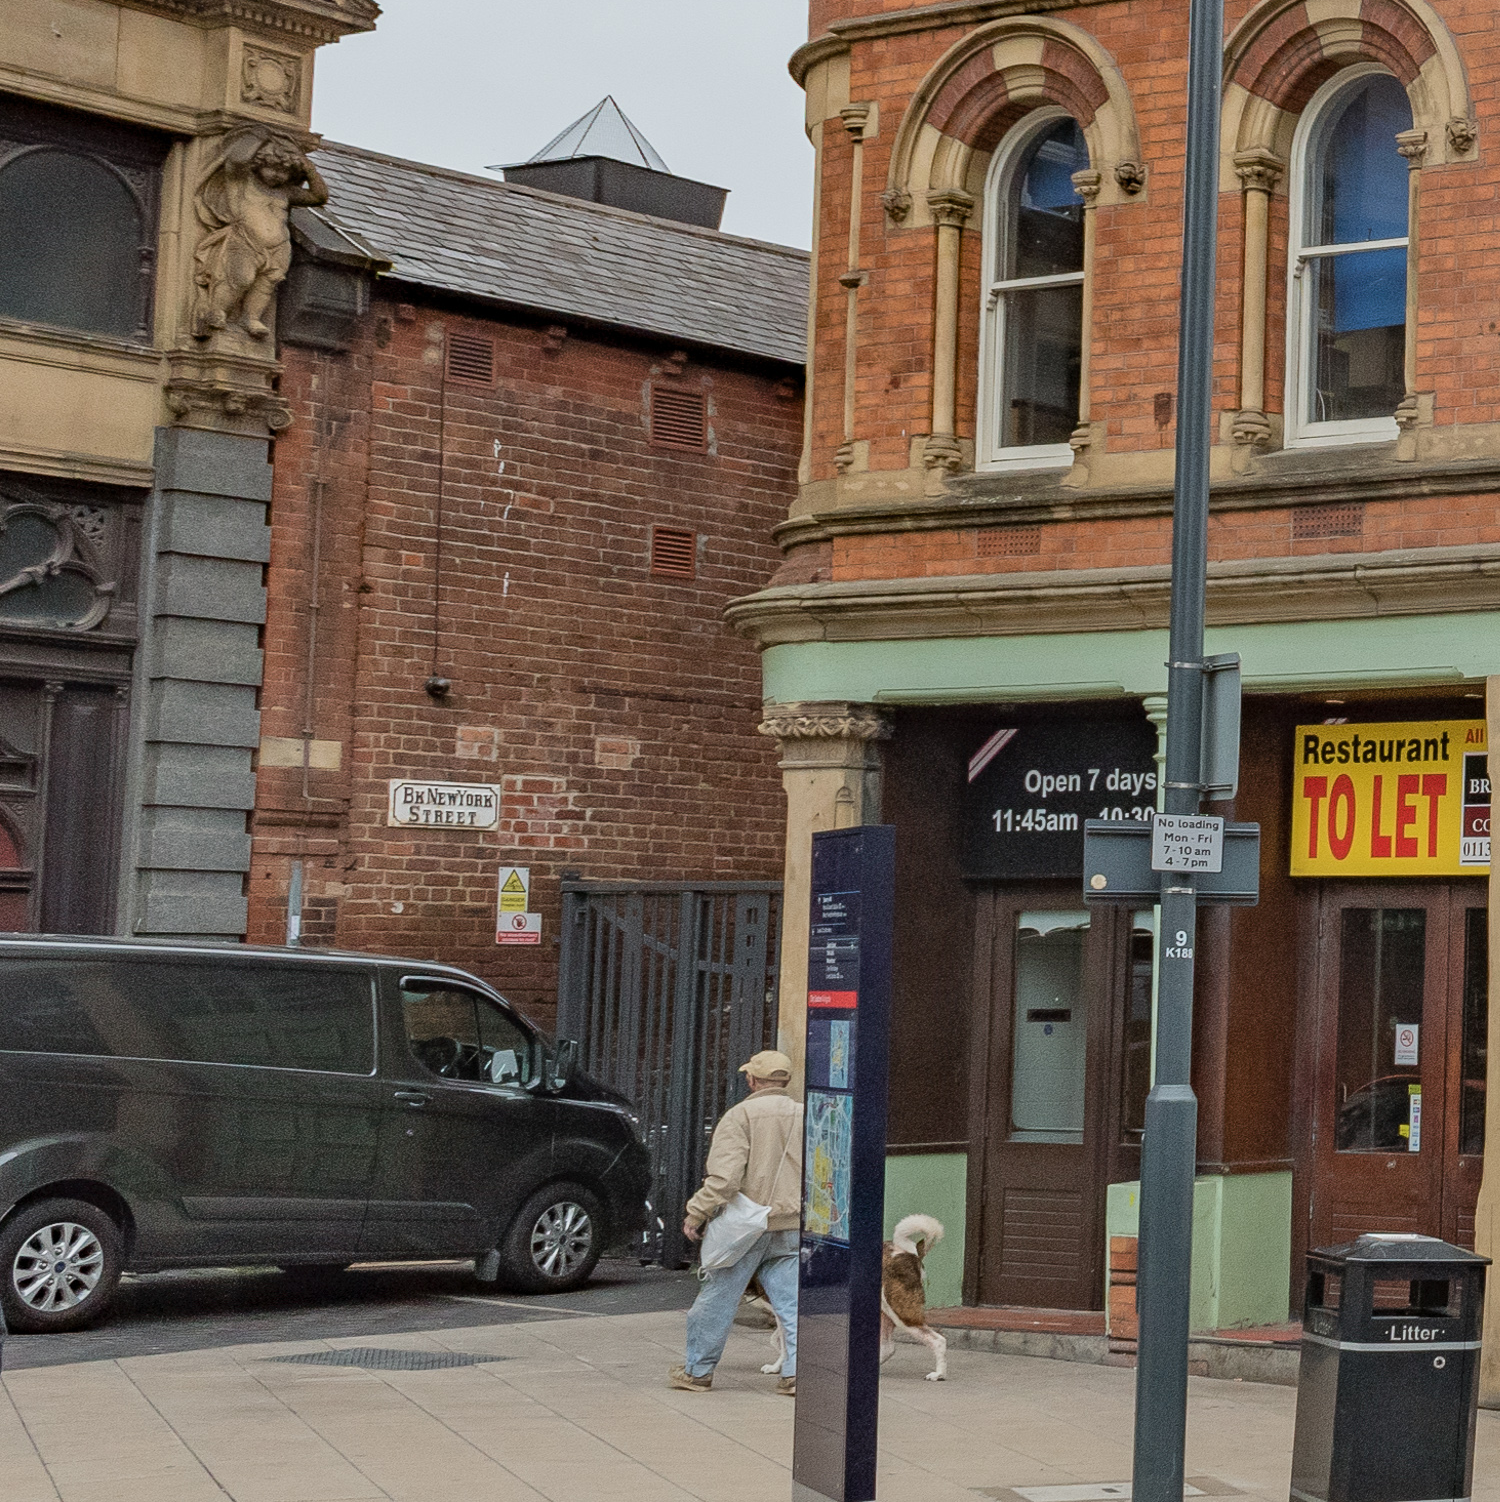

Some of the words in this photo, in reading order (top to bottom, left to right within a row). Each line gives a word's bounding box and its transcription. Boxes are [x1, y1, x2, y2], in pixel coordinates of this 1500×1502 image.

[1303, 731, 1450, 764] Restaurant
[1024, 769, 1081, 798] Open
[1087, 768, 1100, 791] 7
[1106, 768, 1157, 796] days
[408, 805, 477, 825] STREET
[992, 808, 1078, 832] 11:45am
[1303, 773, 1356, 861] TO
[1370, 773, 1447, 858] LET
[1158, 818, 1174, 828] No
[1178, 819, 1219, 831] loading
[1164, 833, 1188, 842] Mon
[1198, 834, 1213, 843] Fri
[1195, 848, 1211, 856] am
[1175, 930, 1188, 946] 9
[1390, 1325, 1439, 1341] Litter
